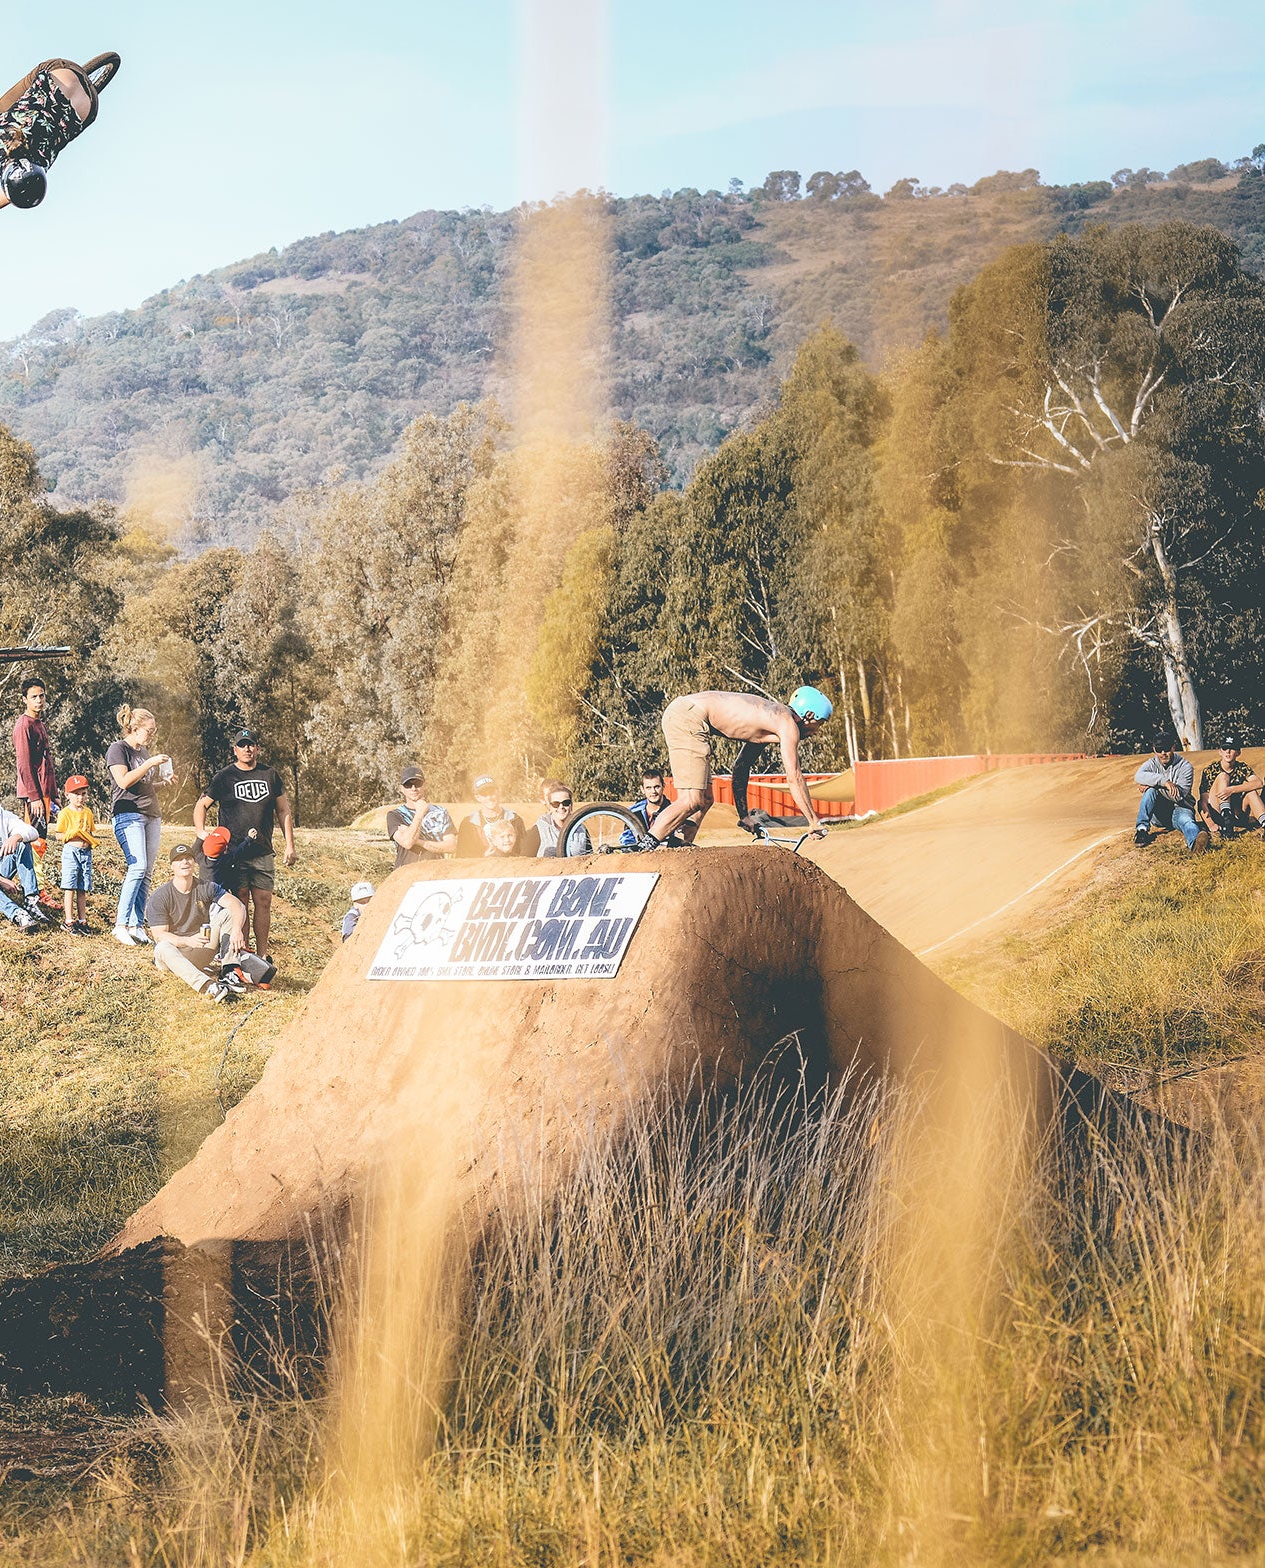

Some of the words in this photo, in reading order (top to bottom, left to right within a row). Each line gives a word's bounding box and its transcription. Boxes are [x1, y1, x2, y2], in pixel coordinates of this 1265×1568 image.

[237, 782, 268, 799] DEUS
[465, 879, 552, 921] BACK
[545, 876, 625, 918] BONE
[447, 917, 634, 963] BMX.COM.AU
[391, 966, 417, 976] OWNED
